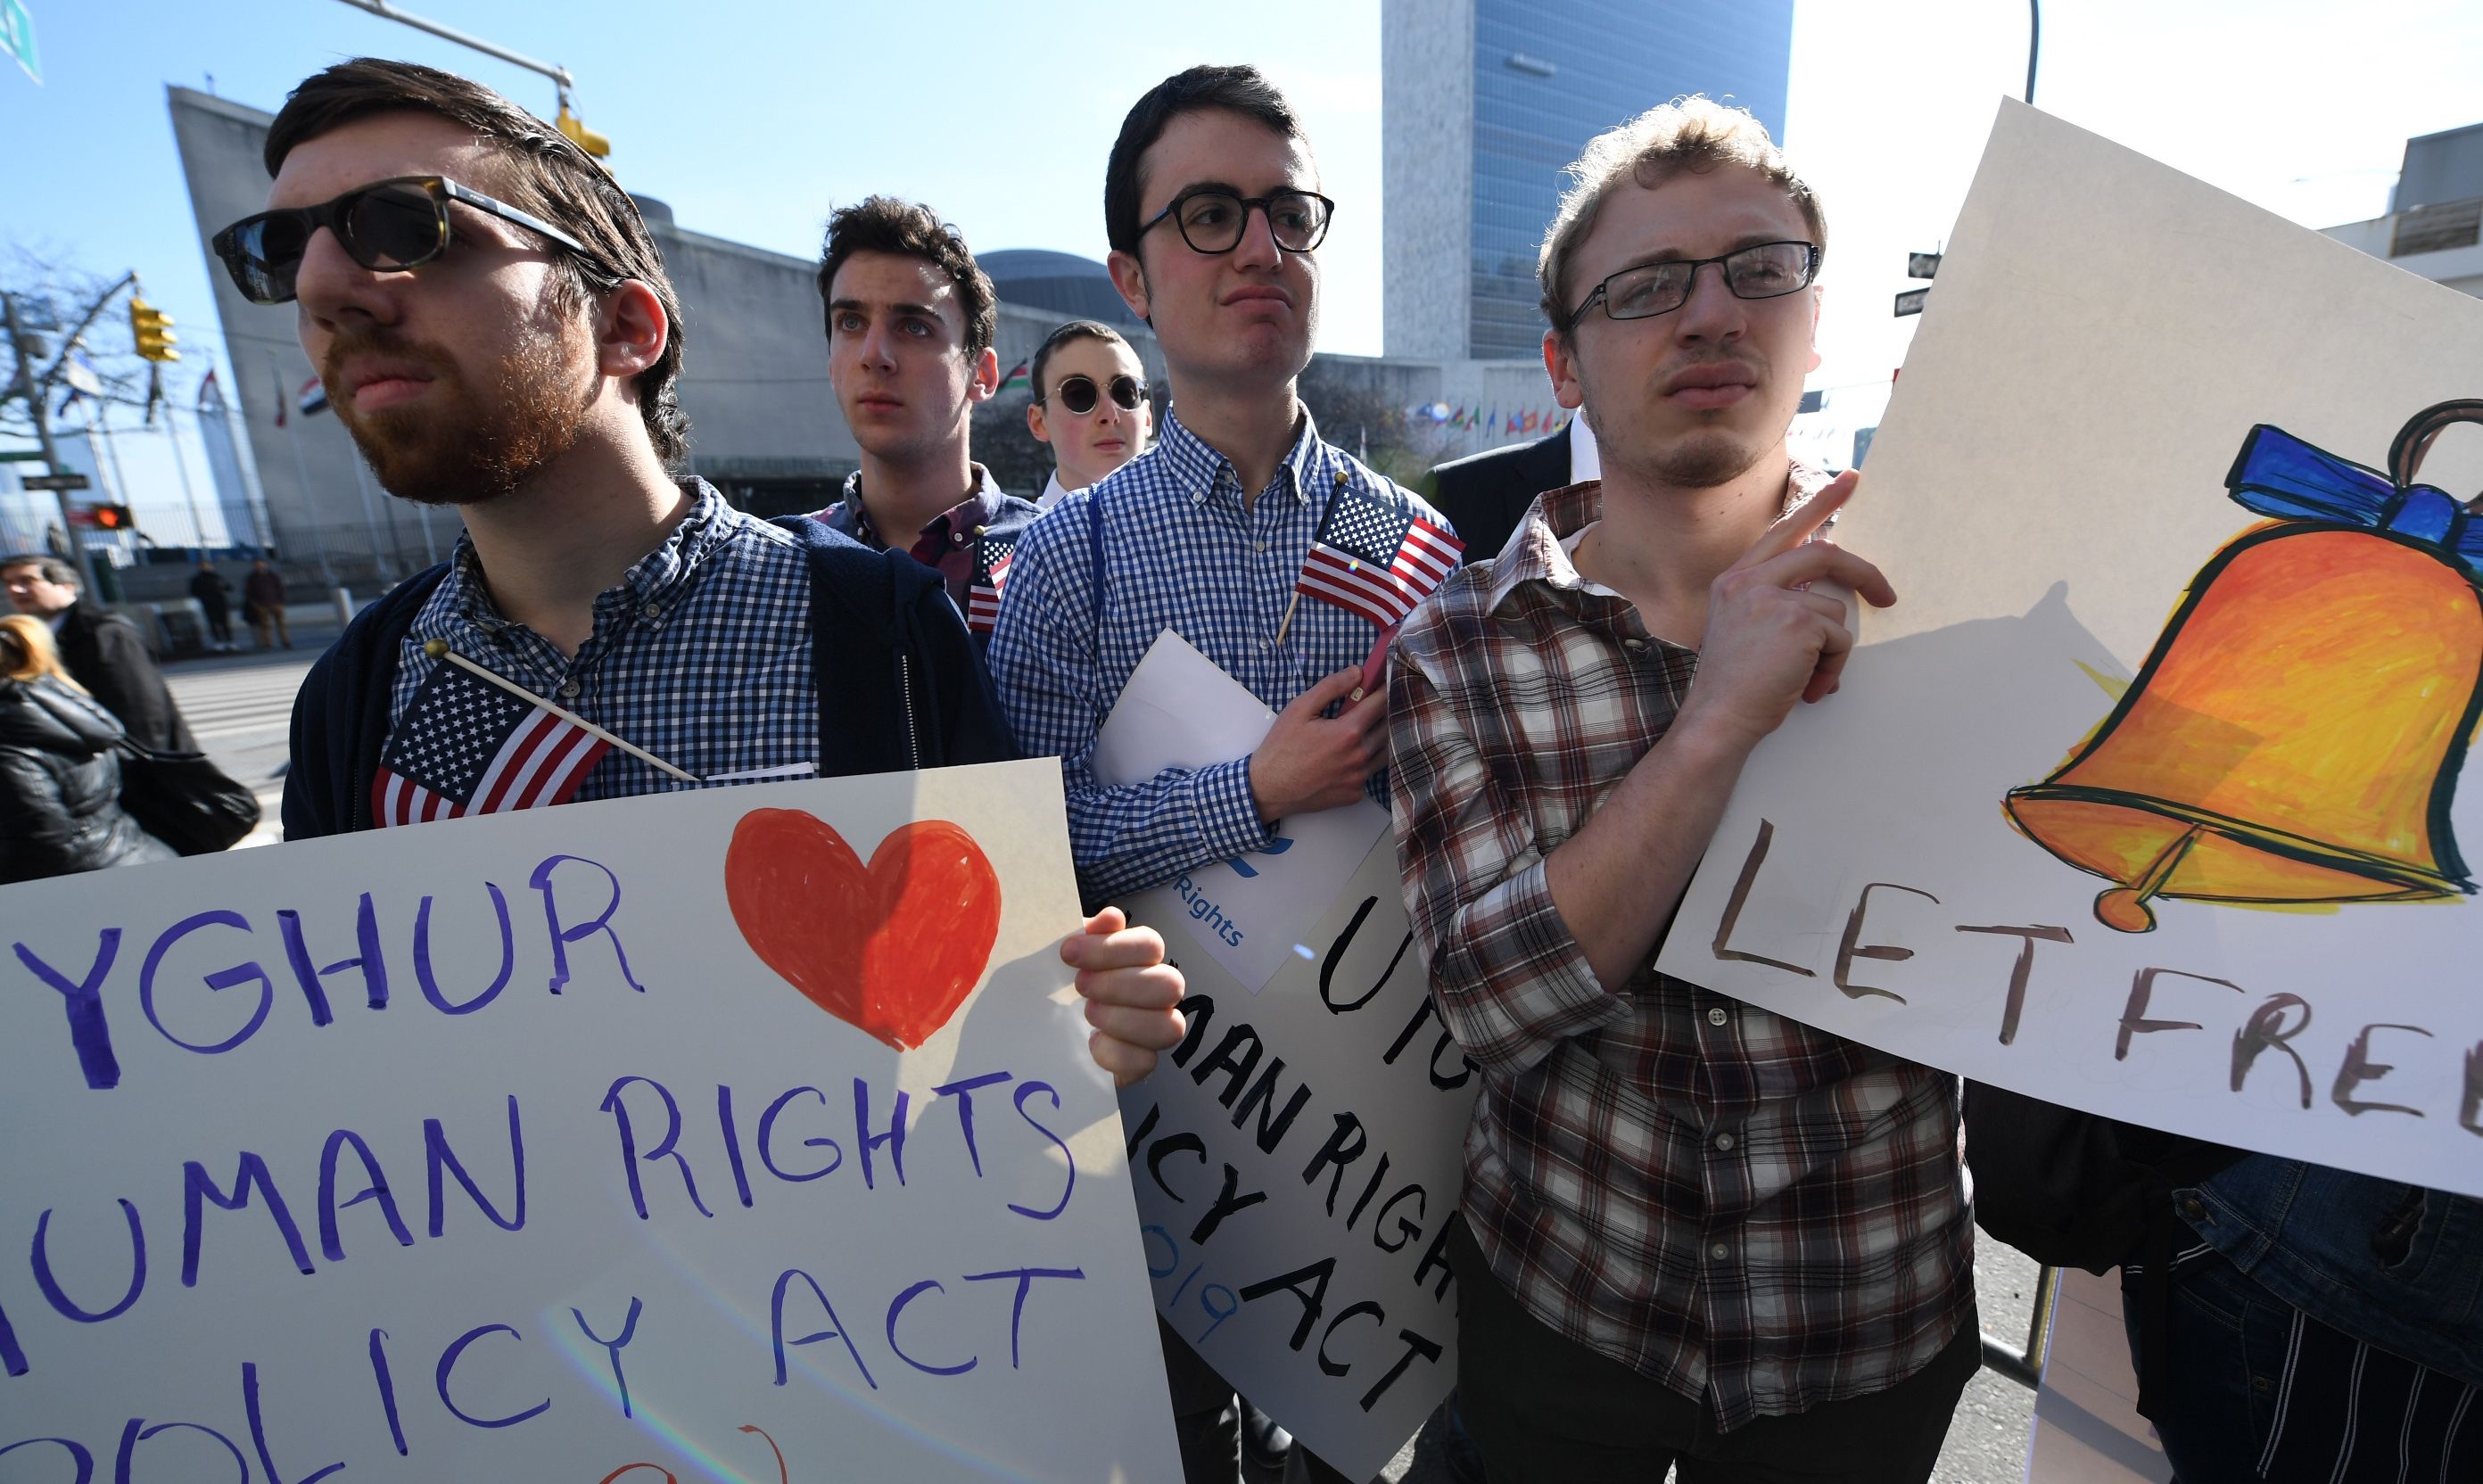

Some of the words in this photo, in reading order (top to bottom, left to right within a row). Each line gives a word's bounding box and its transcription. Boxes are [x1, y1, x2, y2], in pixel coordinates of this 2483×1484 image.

[12, 853, 647, 1090] YGHUR
[1172, 875, 1244, 947] Rights
[1712, 818, 2075, 1047] LET
[0, 1094, 526, 1377] UMAN
[598, 1071, 1076, 1220] RIGHTS
[772, 1266, 1087, 1390] ACT
[1238, 1256, 1444, 1414] ACT
